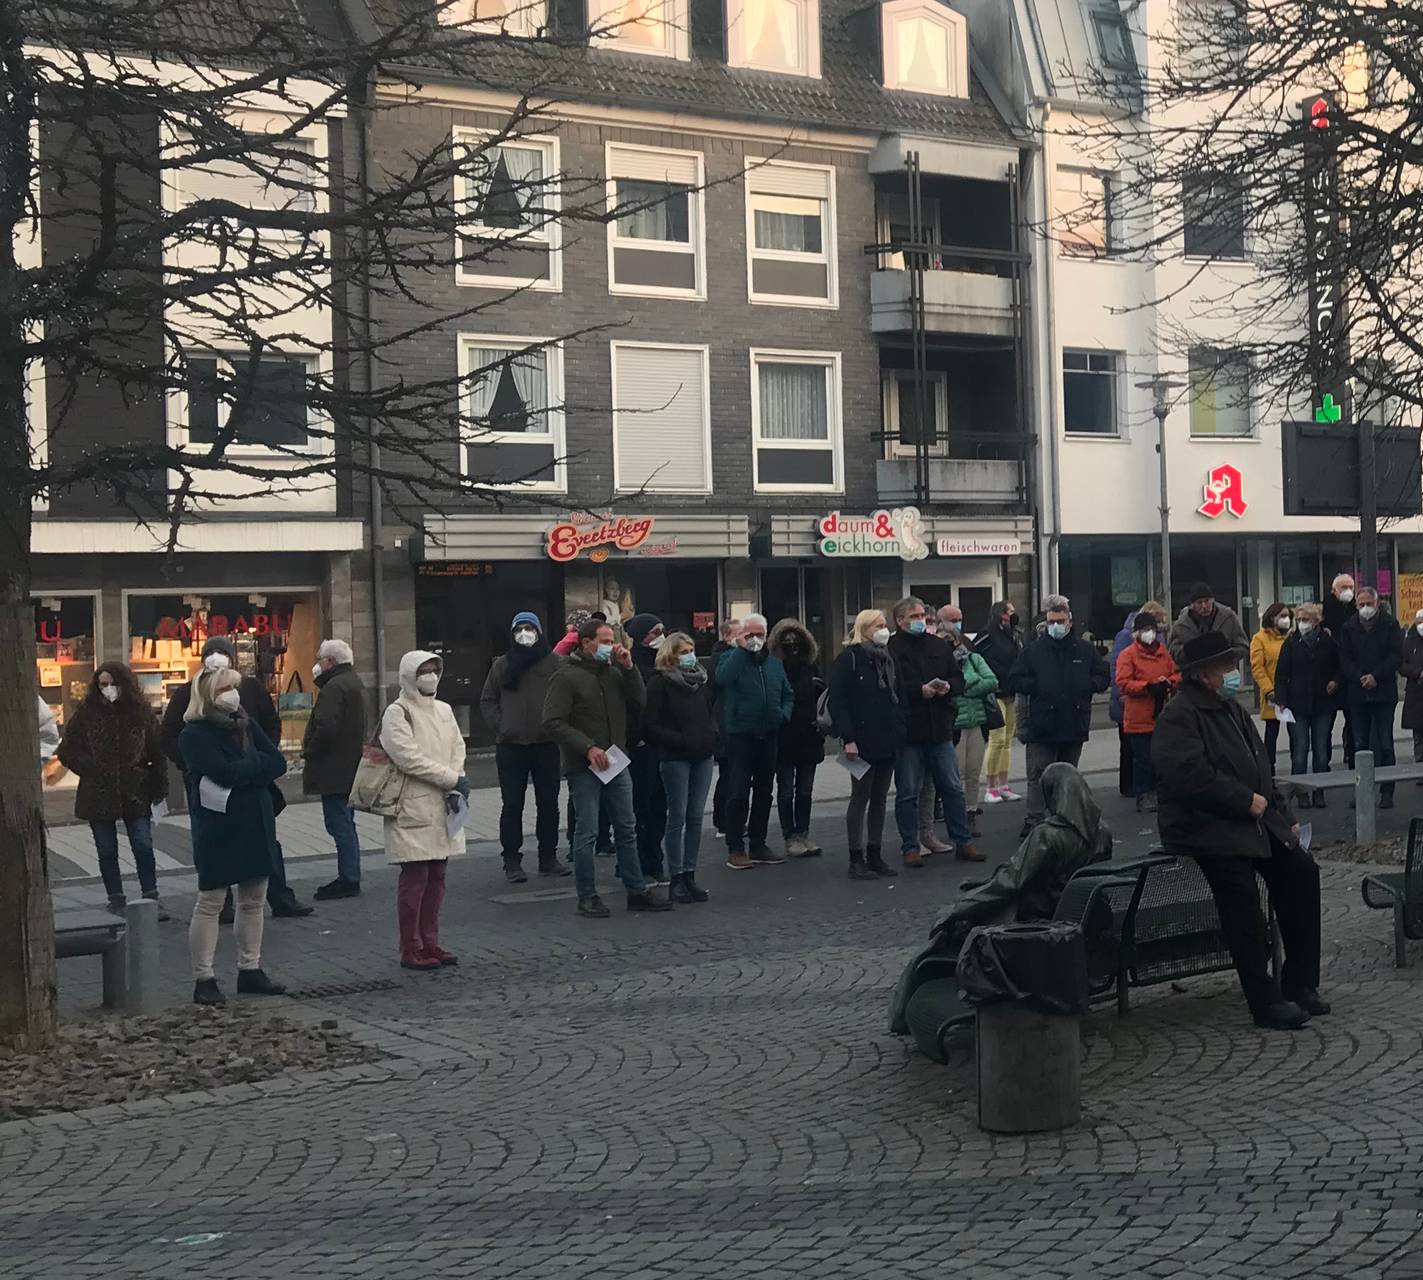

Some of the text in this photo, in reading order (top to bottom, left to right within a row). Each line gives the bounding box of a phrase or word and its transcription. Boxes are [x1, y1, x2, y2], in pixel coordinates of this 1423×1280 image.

[550, 518, 653, 559] Evertzberg
[823, 533, 900, 553] eickhorn
[940, 541, 1019, 554] fleischwaren
